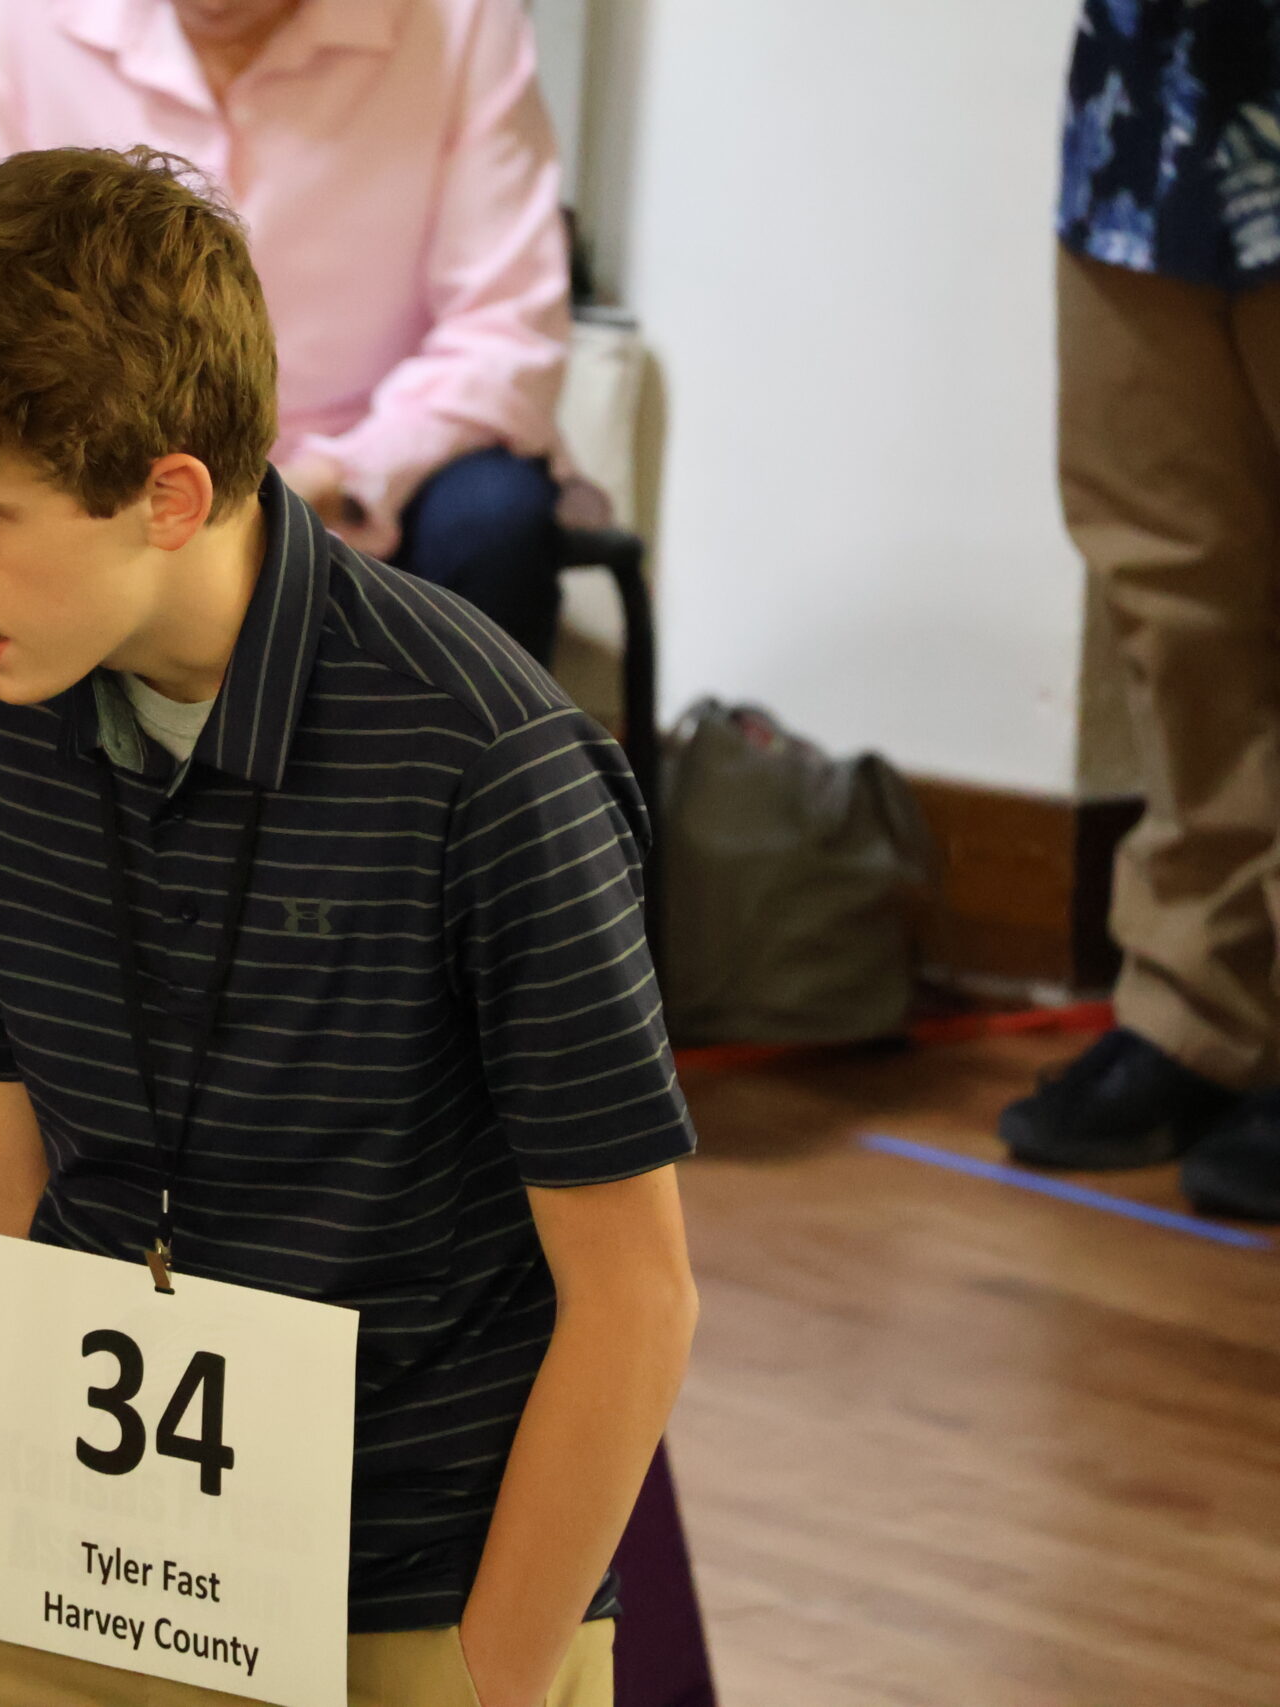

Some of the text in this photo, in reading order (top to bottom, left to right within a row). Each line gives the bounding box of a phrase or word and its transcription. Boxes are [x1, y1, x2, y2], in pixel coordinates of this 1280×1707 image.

[76, 1329, 234, 1496] 34
[81, 1541, 221, 1603] Tyler Fast
[43, 1591, 259, 1677] Harvey County
